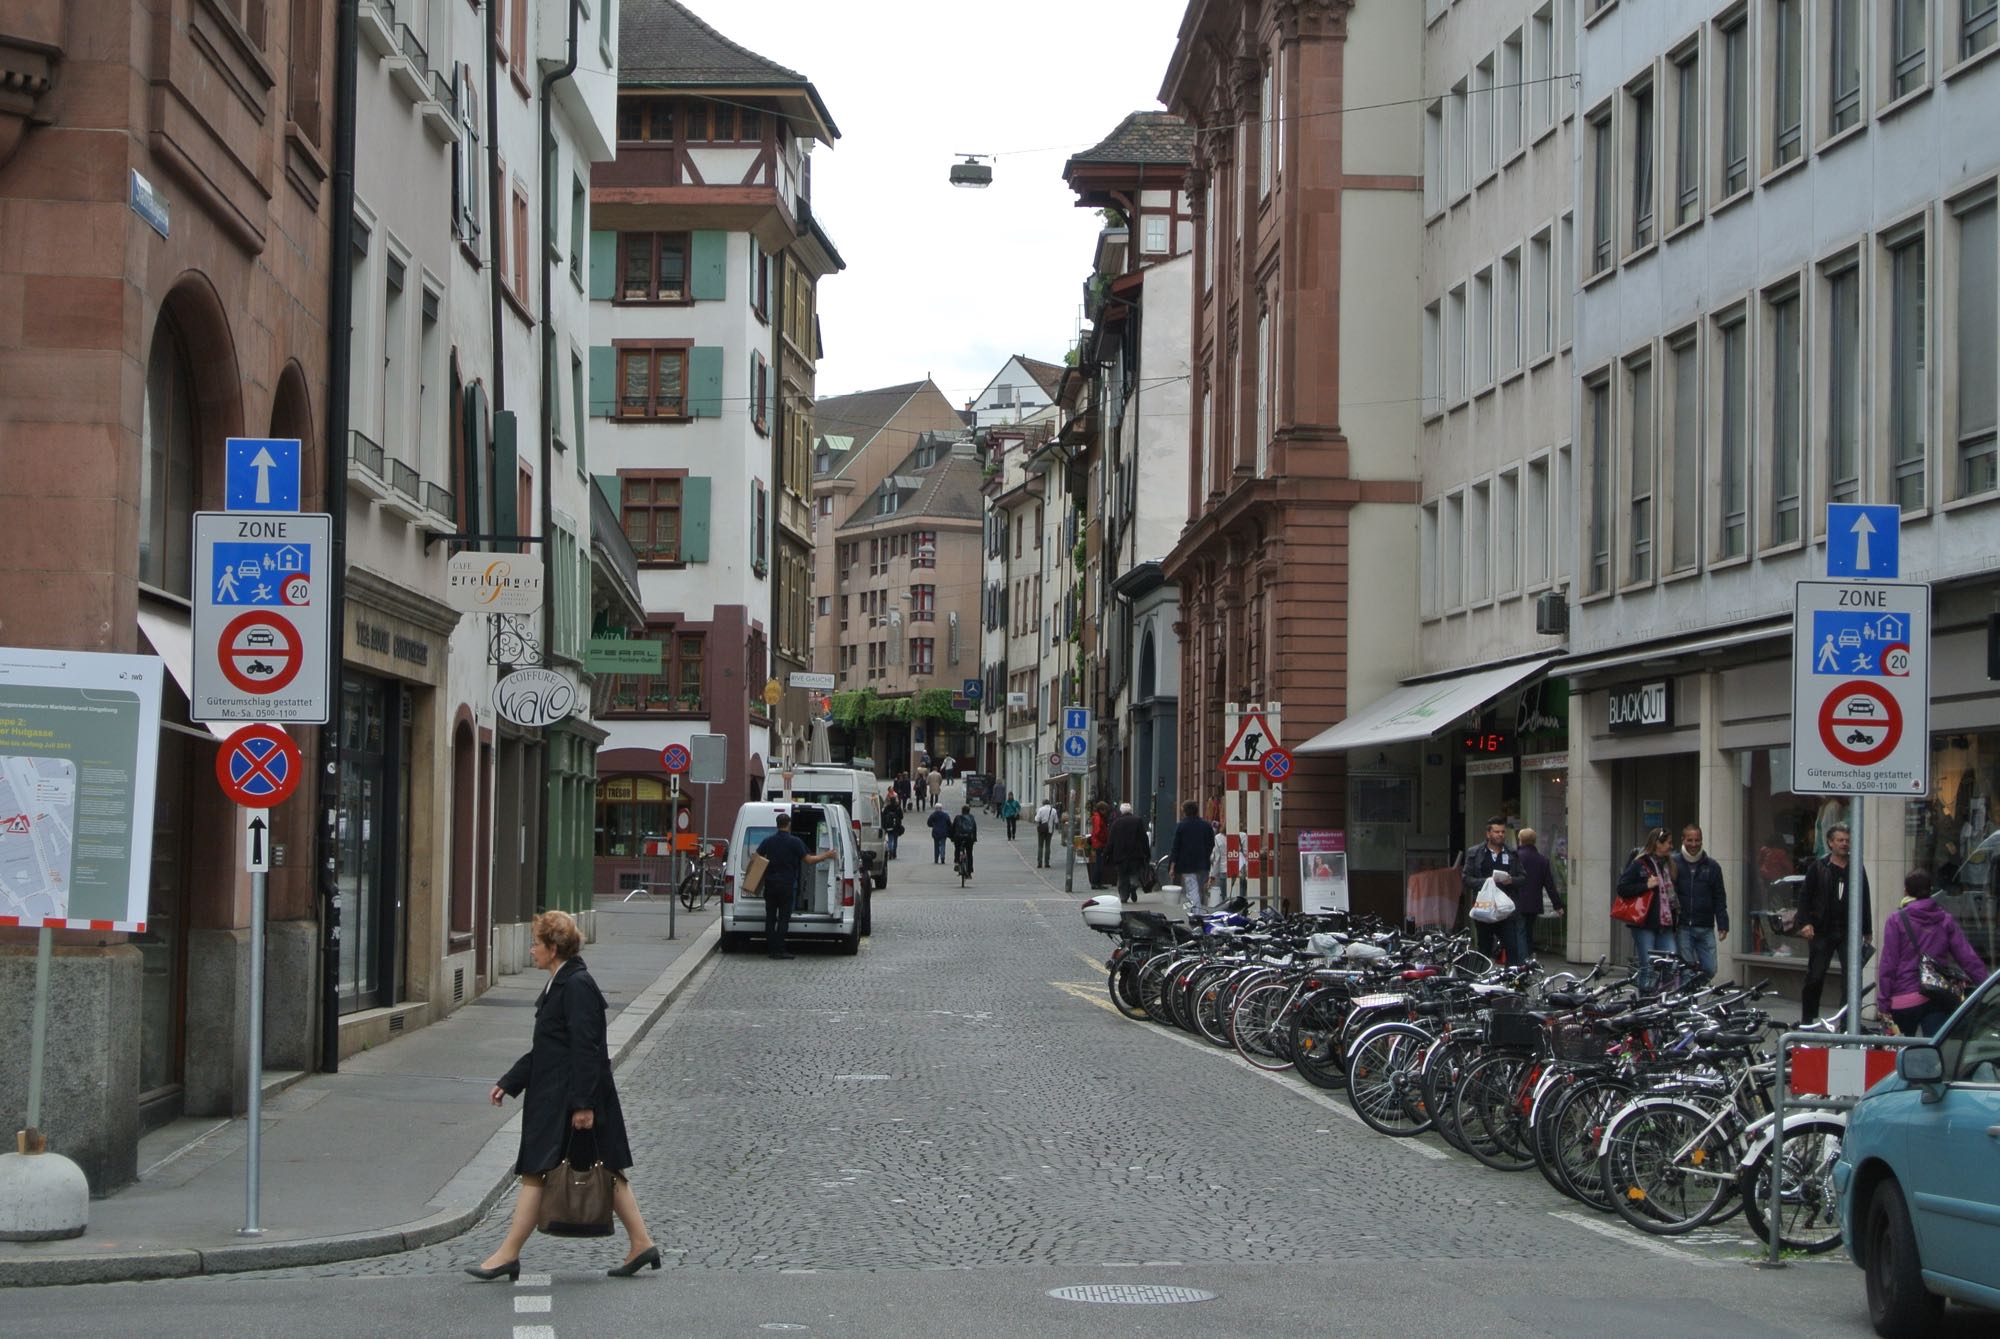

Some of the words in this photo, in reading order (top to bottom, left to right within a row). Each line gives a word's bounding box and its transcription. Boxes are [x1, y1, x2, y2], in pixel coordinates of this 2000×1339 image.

[238, 521, 287, 538] ZONE
[291, 585, 307, 599] 20
[1838, 590, 1887, 607] ZONE
[1891, 655, 1908, 669] 20
[509, 671, 558, 684] COIFFURE
[207, 697, 271, 708] Güterumschlag
[273, 698, 313, 708] gestattet
[1807, 768, 1871, 779] Güterumschlag
[1873, 770, 1912, 780] gestattet
[608, 787, 631, 798] TRESOR
[1227, 850, 1238, 858] ab
[1248, 851, 1259, 859] ab
